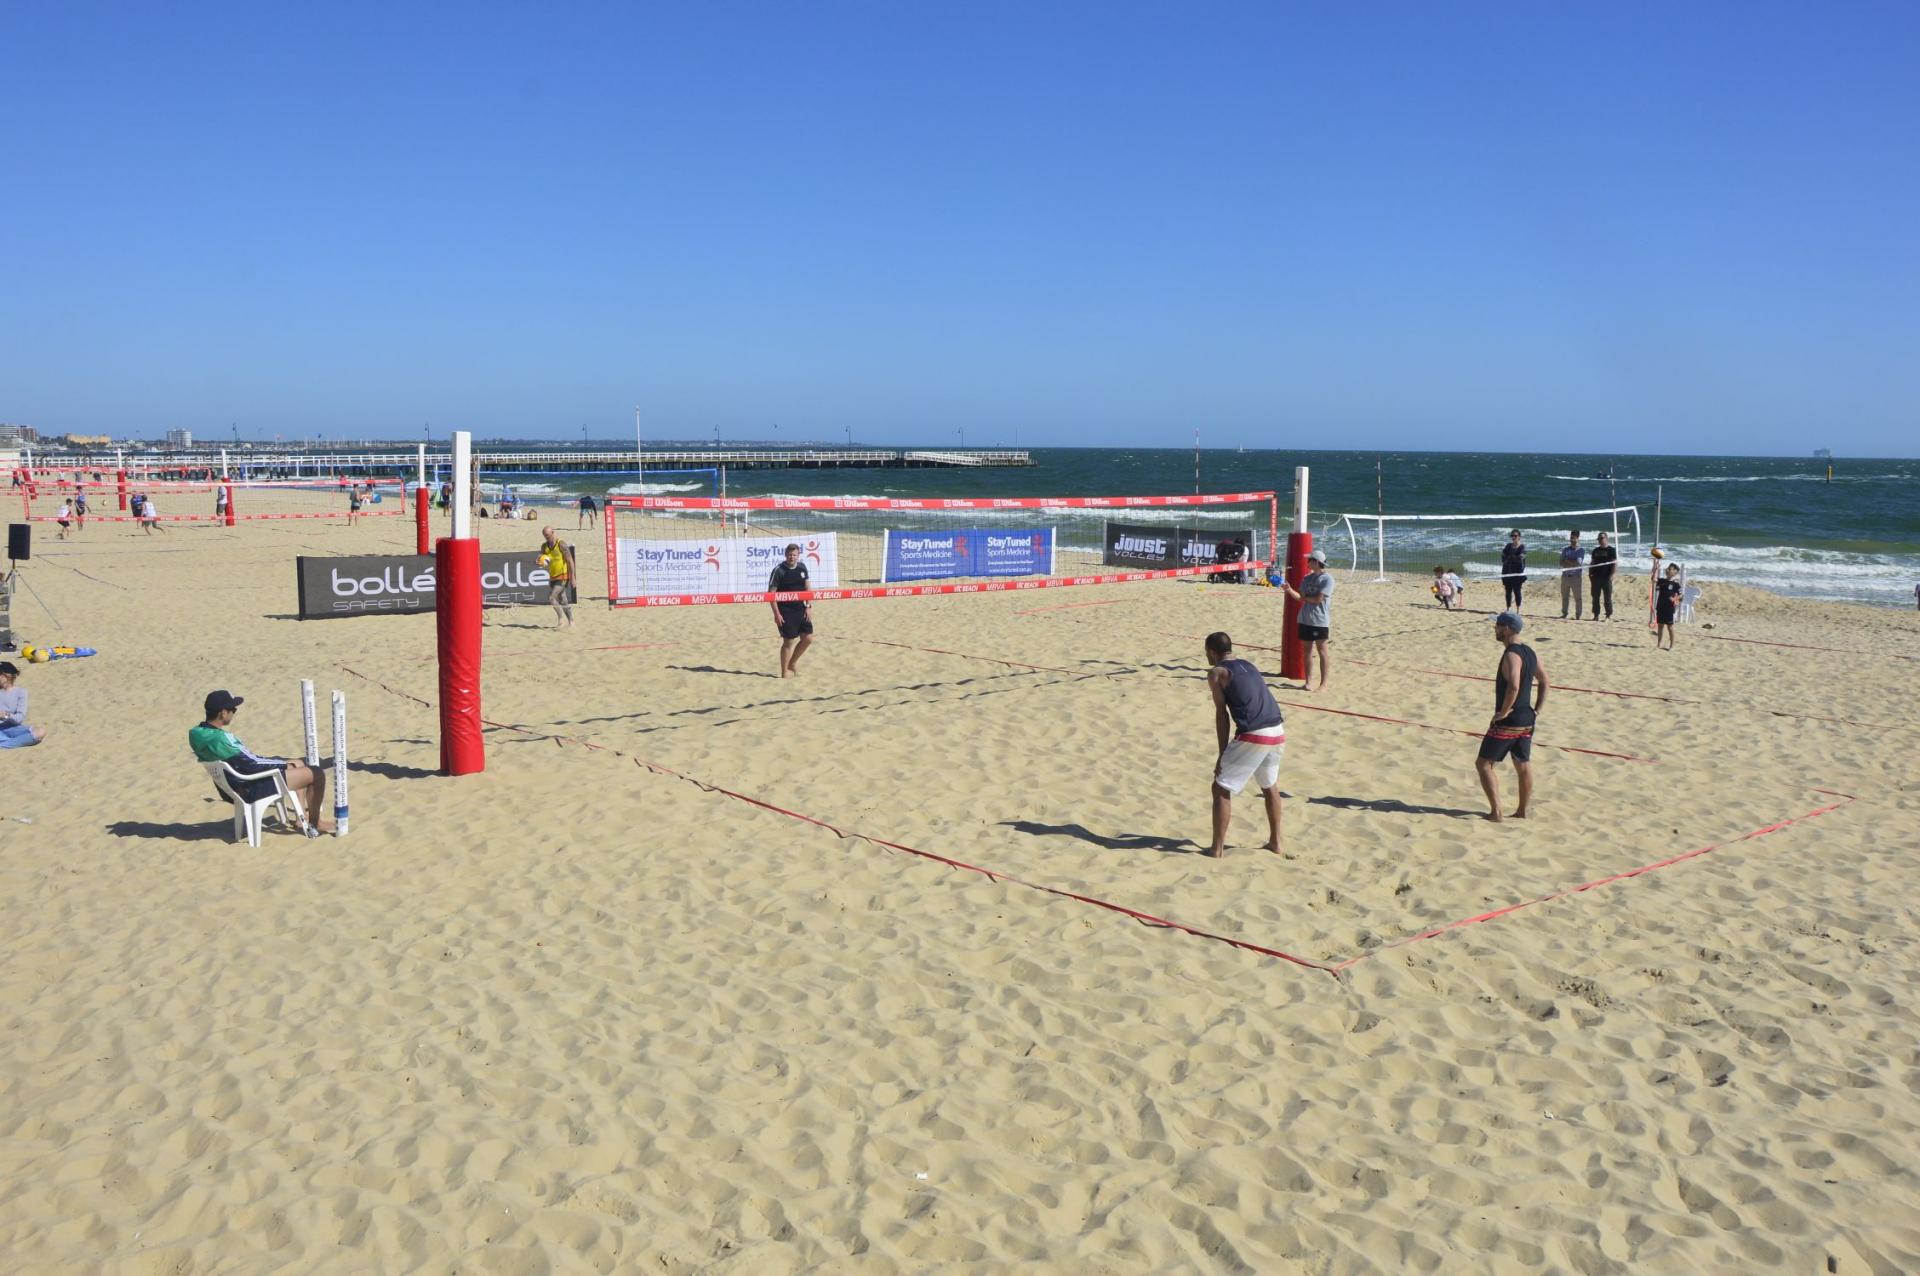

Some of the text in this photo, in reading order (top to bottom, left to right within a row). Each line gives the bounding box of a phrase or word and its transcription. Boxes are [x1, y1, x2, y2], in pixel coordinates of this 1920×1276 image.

[655, 498, 684, 507] Wilson
[721, 499, 749, 507] Wilson
[784, 499, 811, 508] Wilson
[901, 538, 953, 552] StayTuned
[988, 536, 1032, 549] StayTuned
[746, 544, 803, 558] StayTud
[987, 547, 1009, 558] Sports
[1182, 539, 1218, 559] jou
[636, 548, 702, 563] StayTuned
[900, 550, 952, 561] Sports Medicine
[1182, 556, 1215, 565] VOLL
[636, 562, 701, 572] Sports Medicine
[745, 558, 771, 568] Sports
[332, 566, 436, 596] bollé
[481, 592, 535, 605] FETY
[774, 592, 799, 601] MBVA
[850, 589, 873, 598] MBVA
[659, 597, 680, 605] BEACH
[692, 595, 718, 603] MBVA
[332, 597, 420, 612] SAFETY
